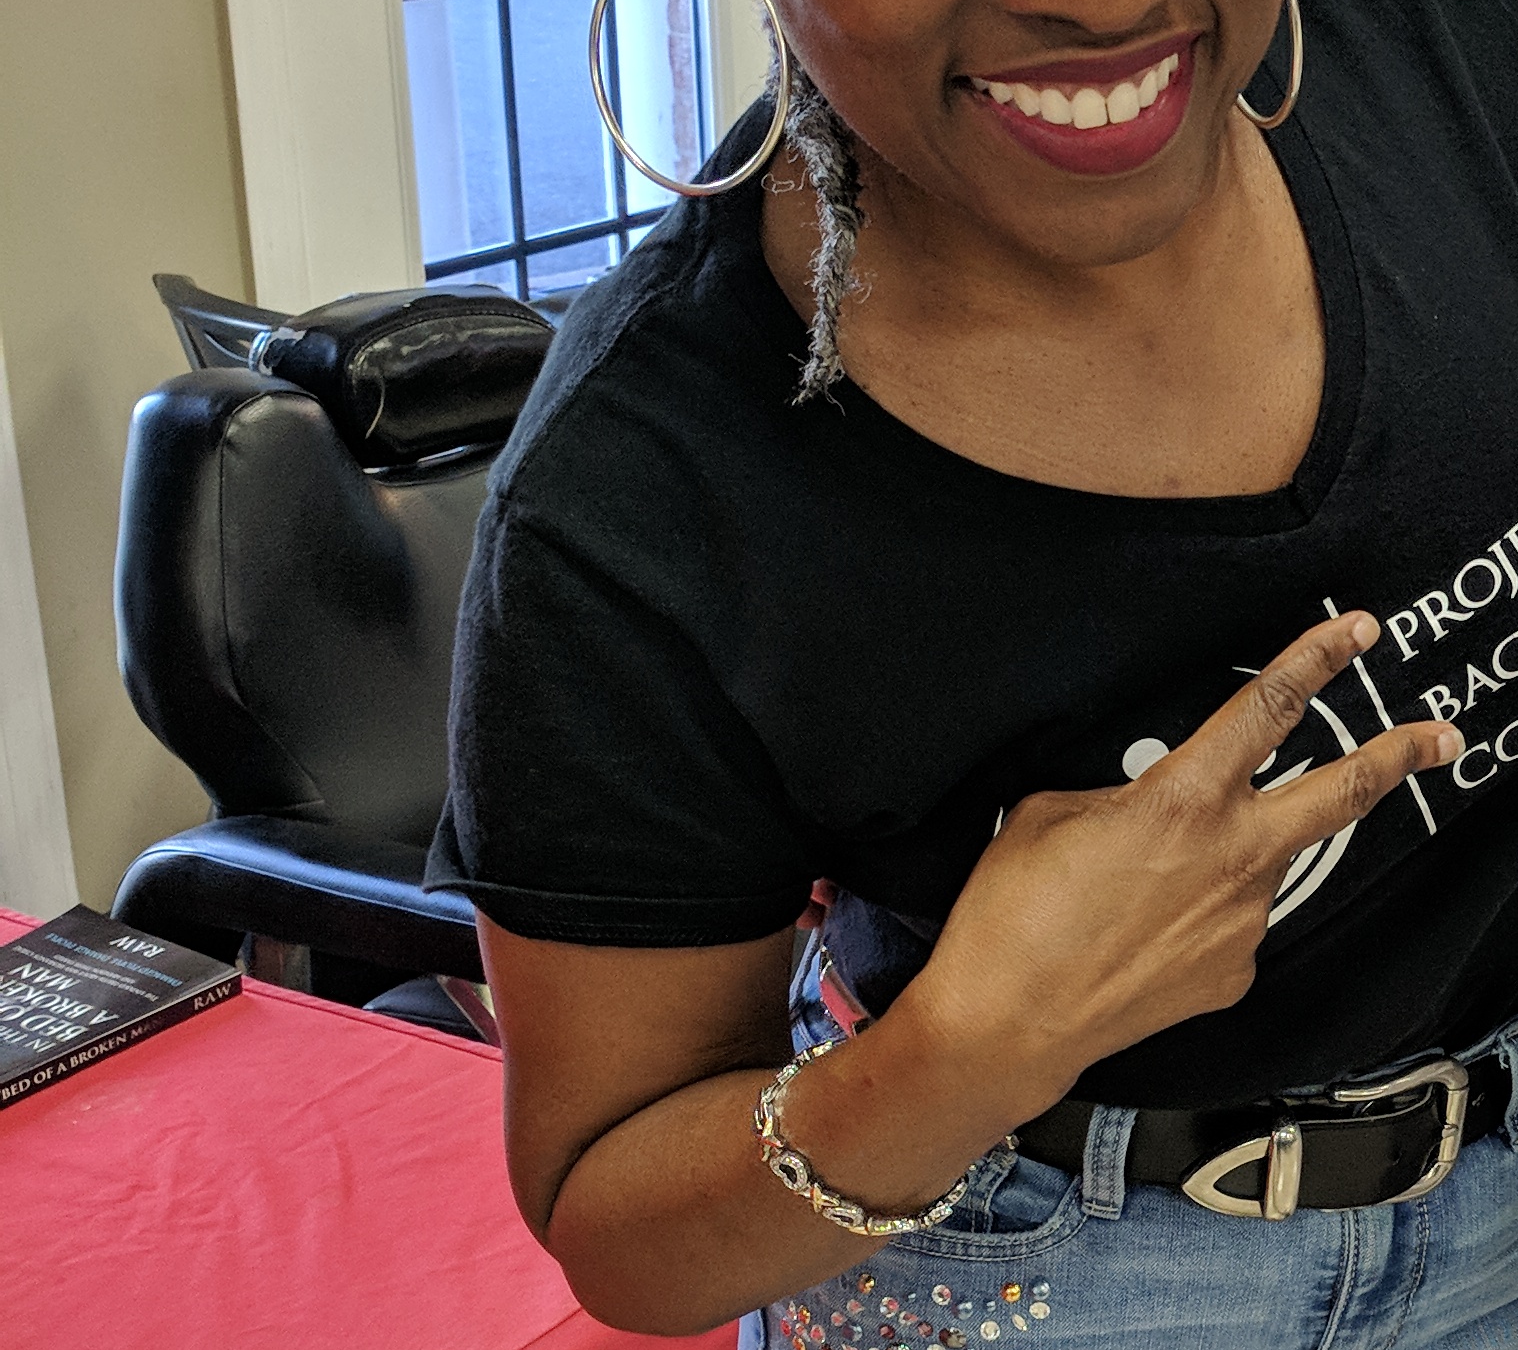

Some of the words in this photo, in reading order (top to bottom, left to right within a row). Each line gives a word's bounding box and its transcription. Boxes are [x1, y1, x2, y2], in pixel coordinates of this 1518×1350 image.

[109, 935, 166, 959] RAW
[7, 962, 81, 991] MAN
[20, 1014, 89, 1042] BED
[89, 1009, 120, 1026] A
[1, 1077, 31, 1101] BED
[33, 1066, 55, 1084] OF
[56, 1061, 68, 1076] A
[69, 1033, 127, 1069] BROKEN
[193, 982, 232, 1011] RAW
[23, 1038, 57, 1053] IN
